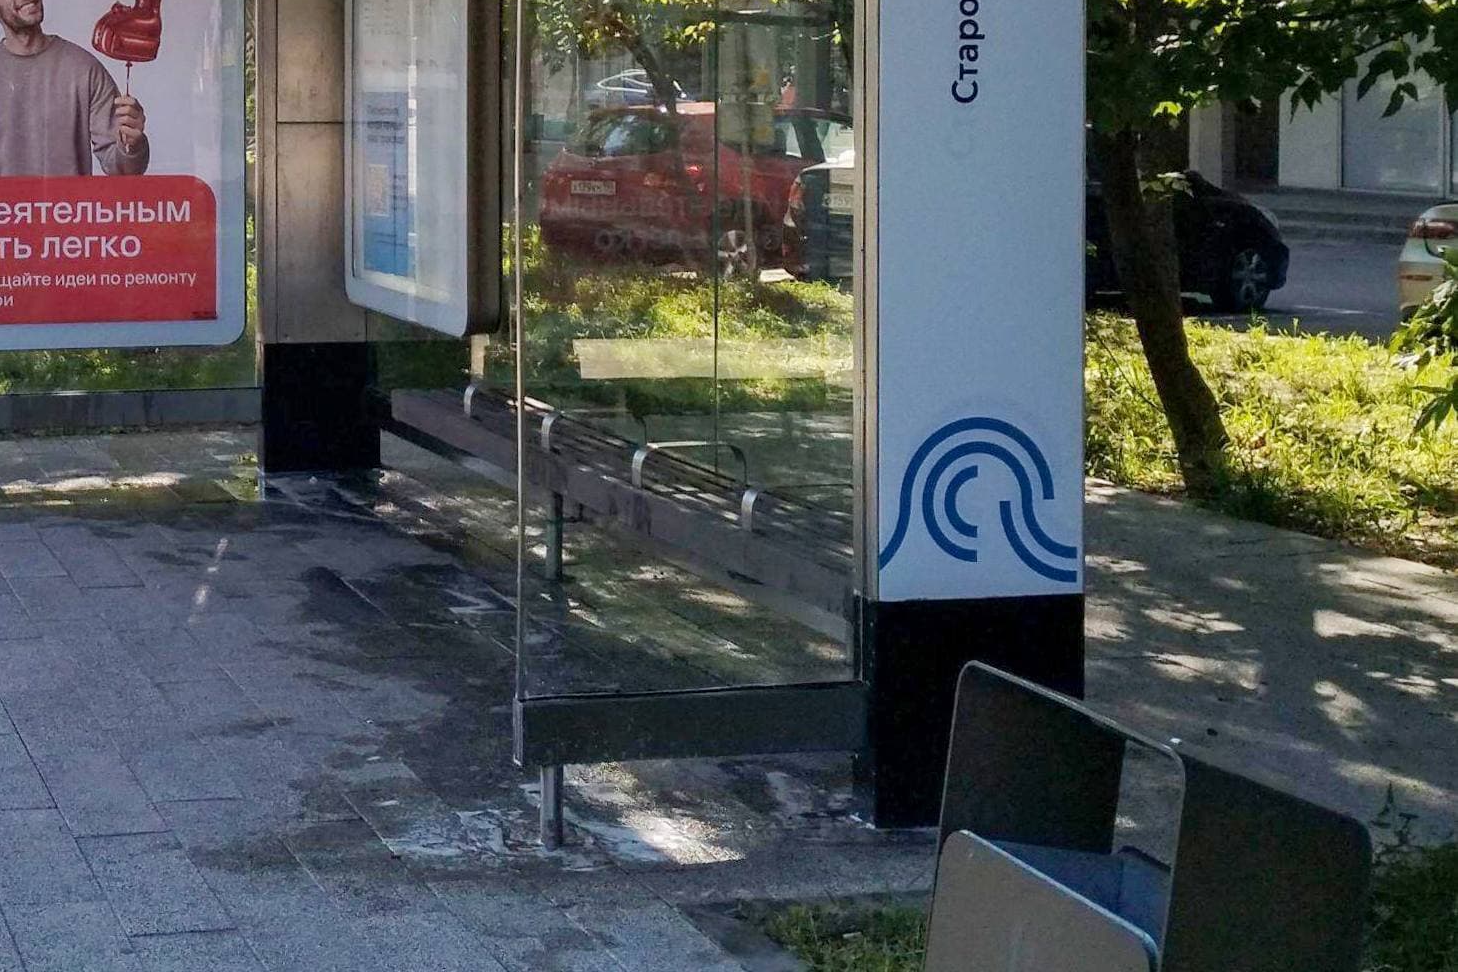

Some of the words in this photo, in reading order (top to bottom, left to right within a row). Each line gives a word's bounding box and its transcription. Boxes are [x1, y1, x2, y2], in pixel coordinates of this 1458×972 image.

[40, 235, 142, 259] легко
[55, 274, 96, 288] идеи
[100, 274, 121, 286] по
[125, 272, 197, 288] ремонту
